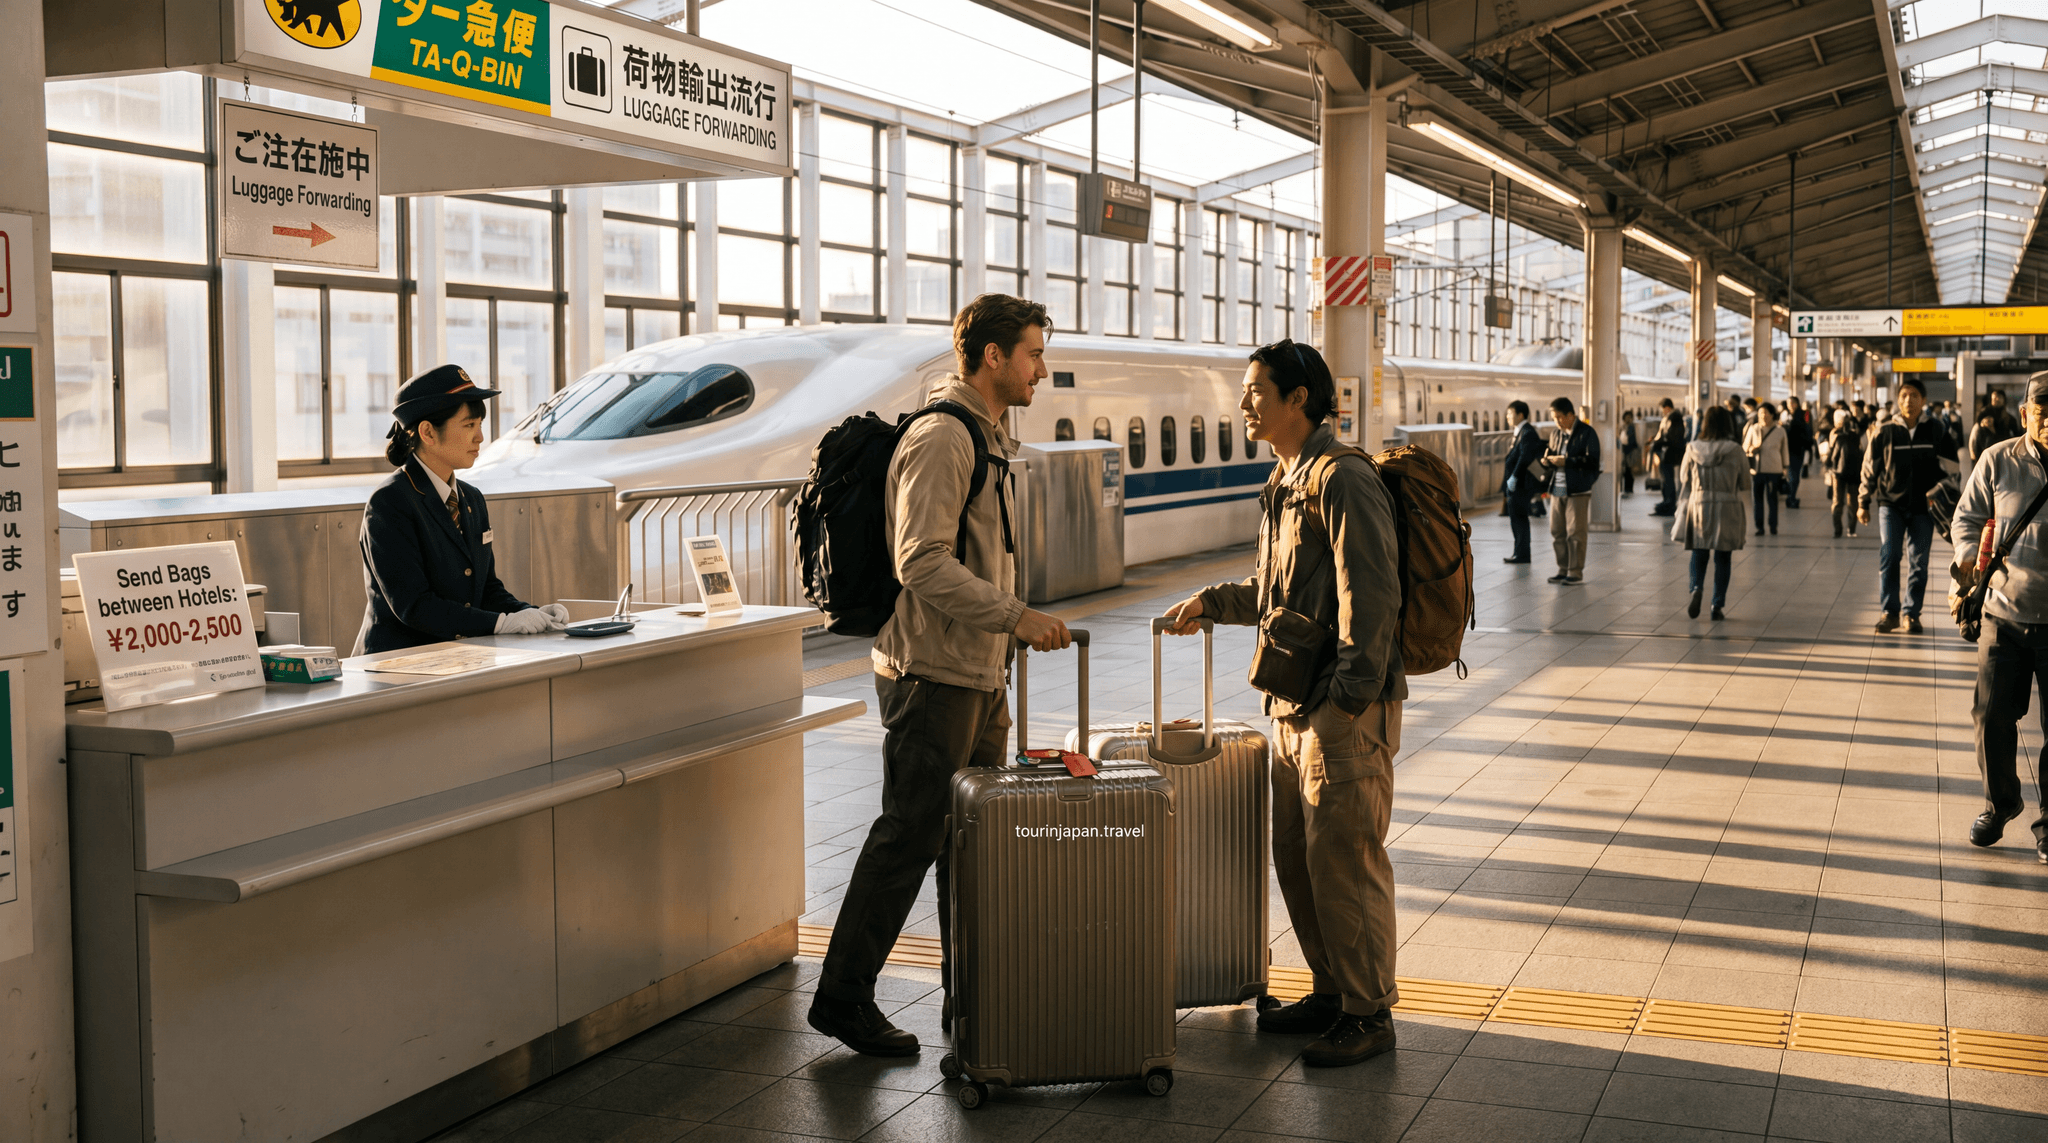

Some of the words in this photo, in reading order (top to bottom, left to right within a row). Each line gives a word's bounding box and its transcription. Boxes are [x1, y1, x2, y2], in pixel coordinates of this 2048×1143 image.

[410, 38, 523, 90] TA-Q-BIN
[623, 44, 776, 122] 荷物輸出流行
[623, 95, 690, 131] LUGGAGE
[694, 113, 777, 150] FORWARDING
[235, 129, 370, 181] ご注在施中
[232, 175, 293, 207] Luggage
[298, 184, 371, 217] Forwarding
[116, 565, 163, 588] Send
[167, 564, 211, 585] Bags
[98, 595, 174, 617] between
[178, 585, 237, 608] Hotels:
[106, 613, 242, 653] ¥2,000-2,500
